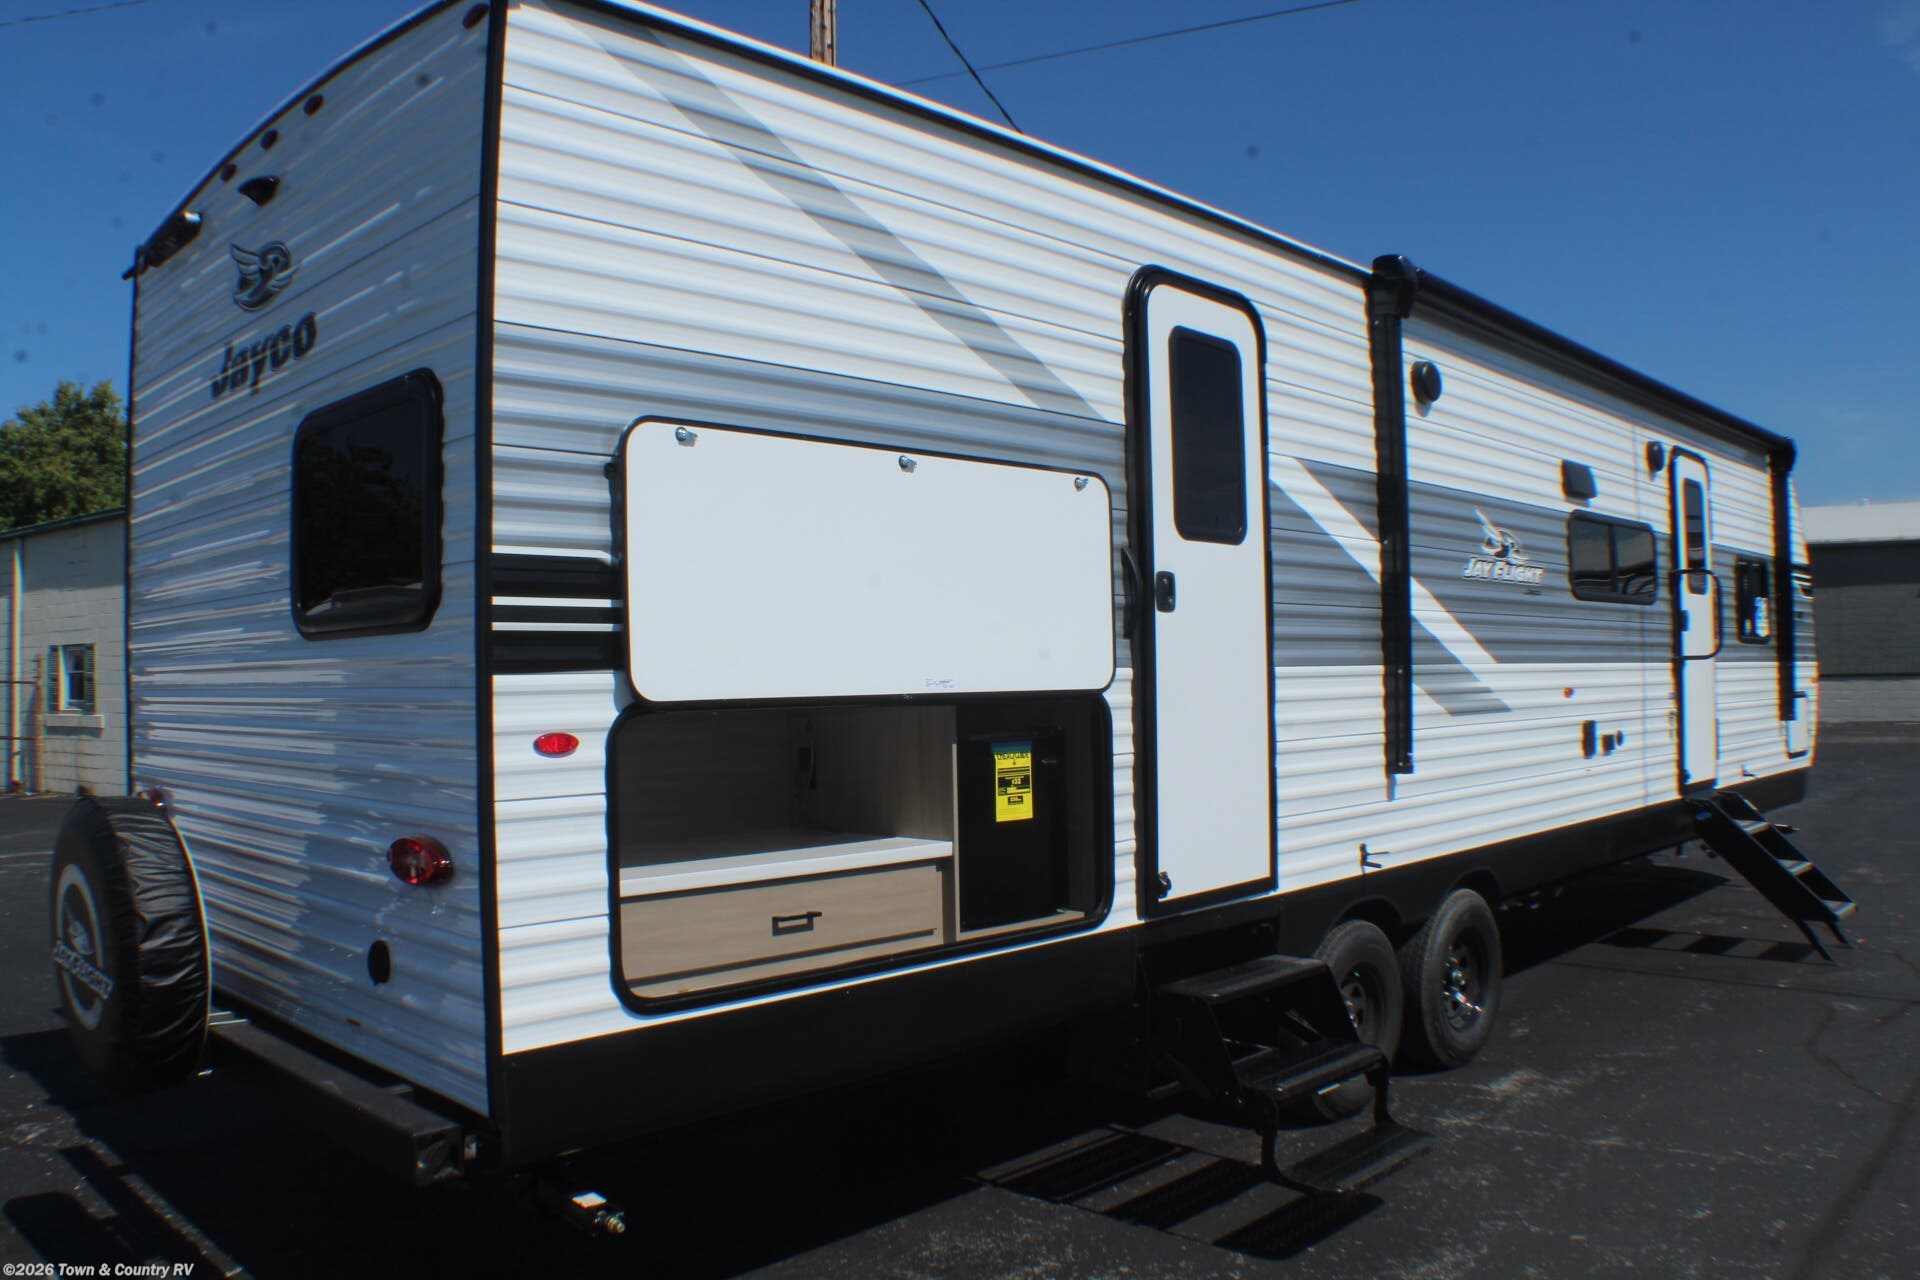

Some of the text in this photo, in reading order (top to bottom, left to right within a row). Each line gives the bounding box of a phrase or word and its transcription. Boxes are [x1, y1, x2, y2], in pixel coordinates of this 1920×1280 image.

[211, 312, 317, 397] Jayco
[1463, 558, 1544, 586] JAY FLIGHT
